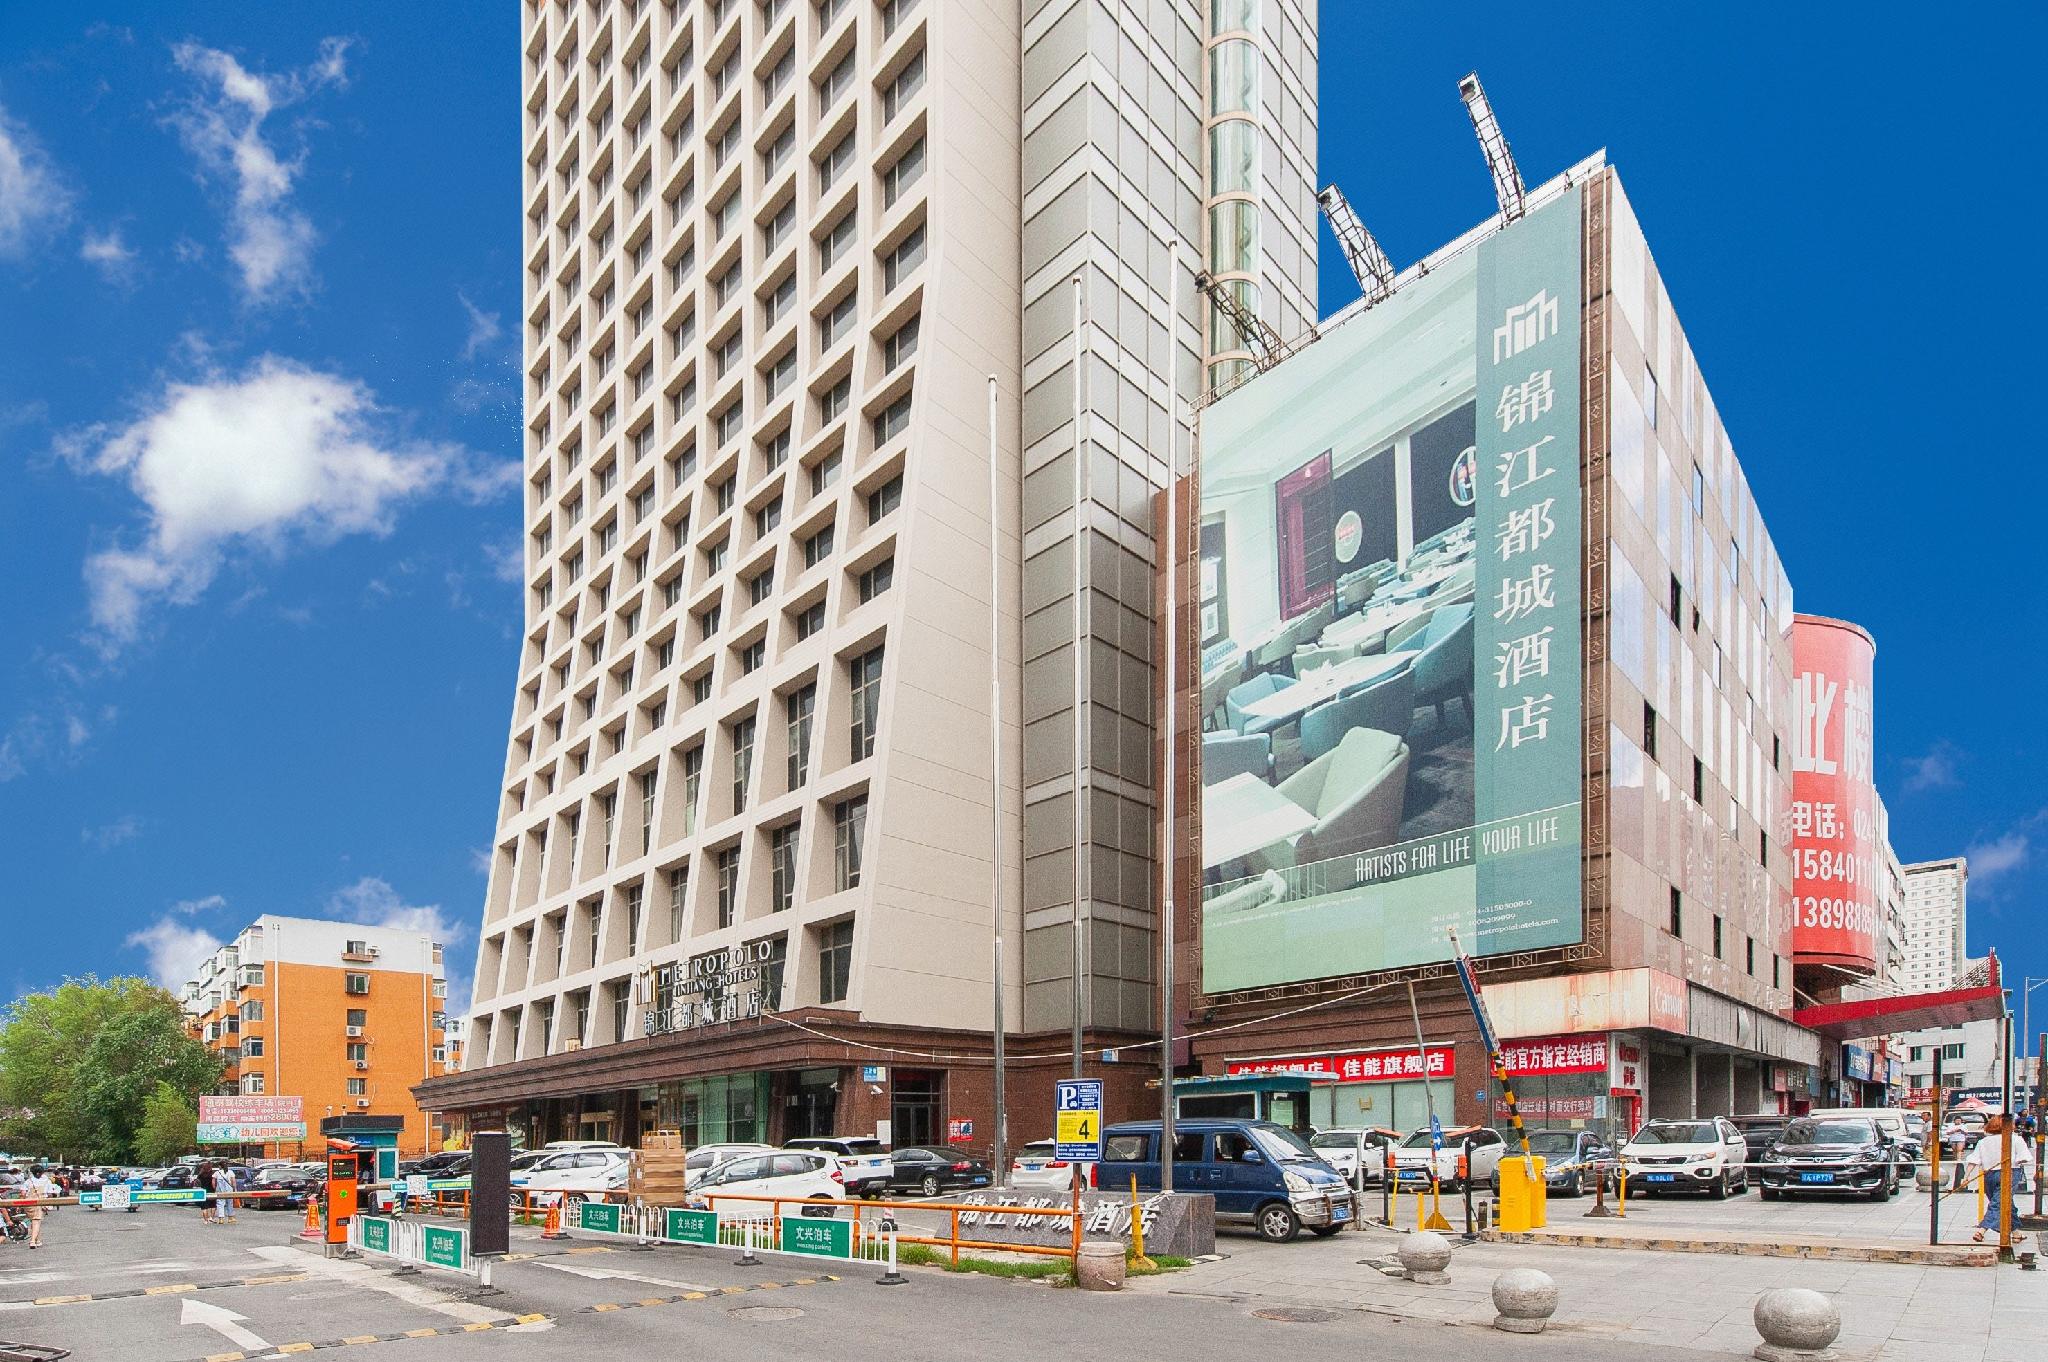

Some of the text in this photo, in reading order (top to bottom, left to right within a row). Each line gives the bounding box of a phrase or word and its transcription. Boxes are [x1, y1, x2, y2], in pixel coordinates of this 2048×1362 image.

[1494, 369, 1556, 752] 锦江都城酒店
[1355, 817, 1559, 881] ARTISTS FOR LIFE YOUR LIFE
[661, 940, 771, 985] METROPOLO
[719, 966, 758, 987] HOTELS
[643, 988, 761, 1035] 锦江都城酒店
[1343, 1053, 1445, 1077] 佳能旗舰店
[1060, 1087, 1077, 1110] P
[1079, 1119, 1090, 1140] 4
[677, 1216, 705, 1231] 文兴泊车
[795, 1225, 832, 1242] 文兴泊车
